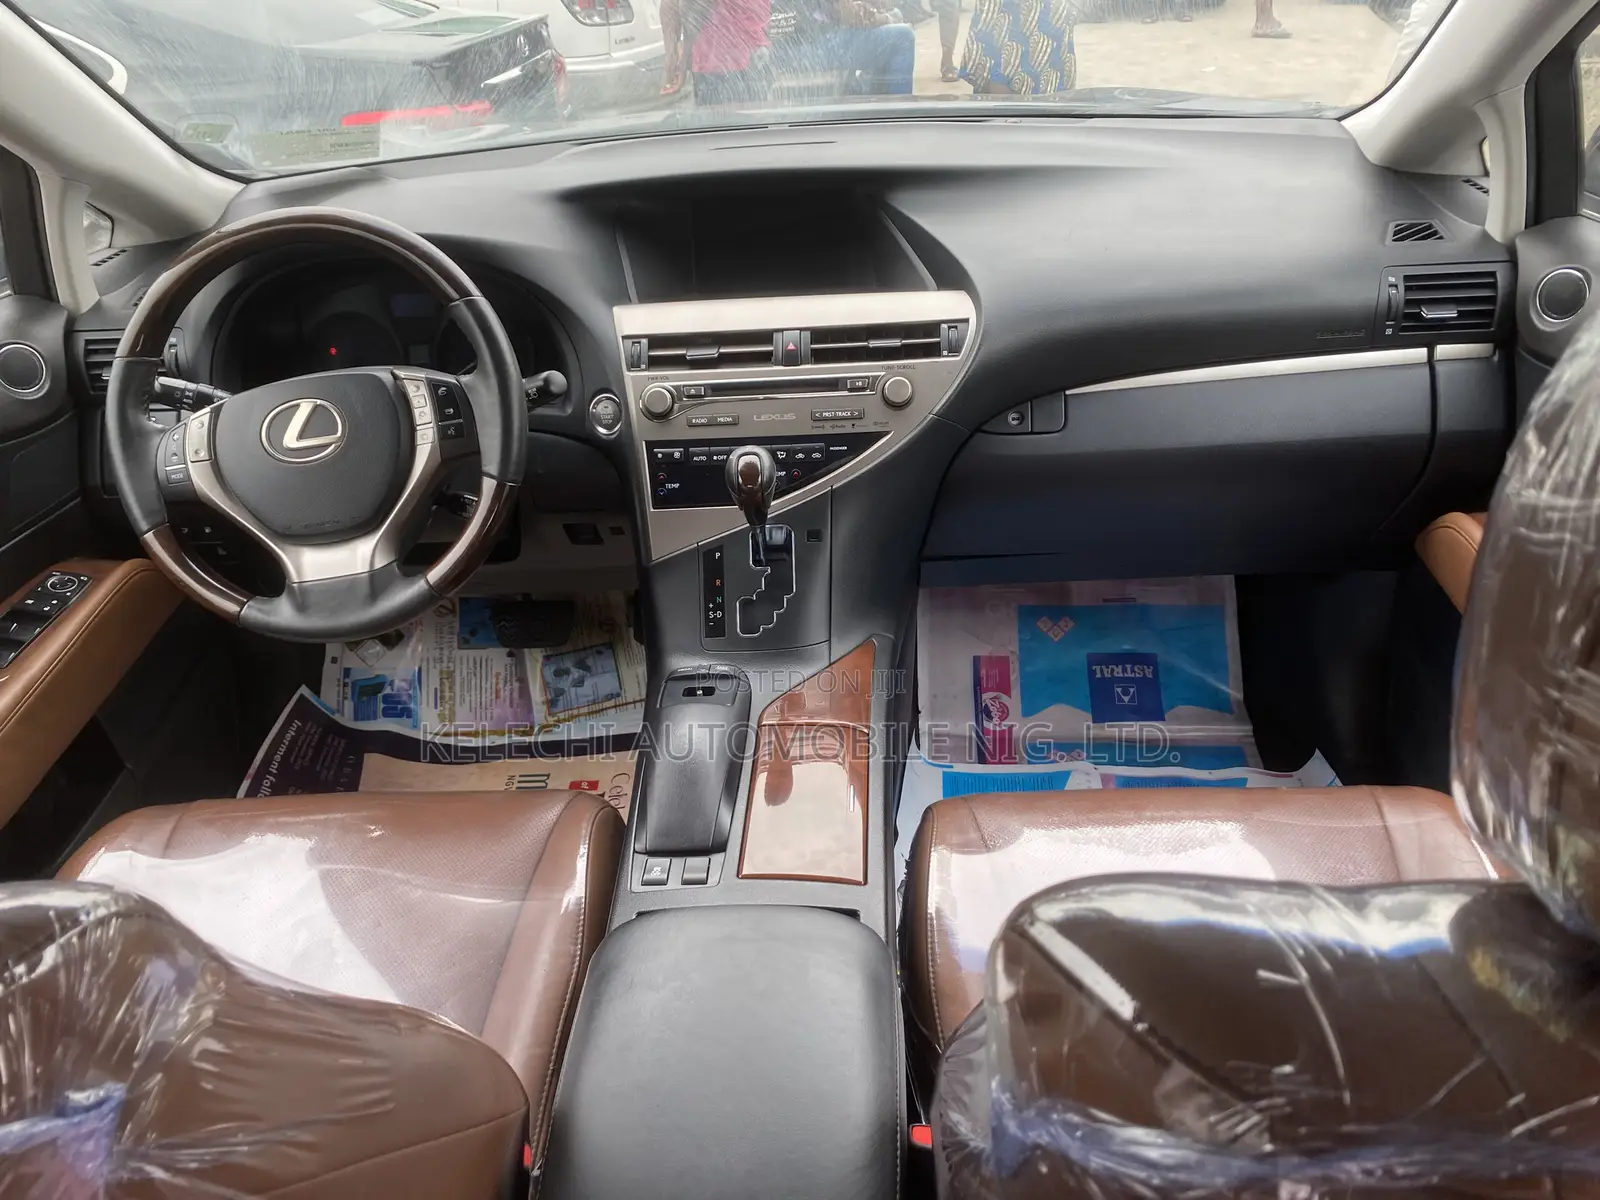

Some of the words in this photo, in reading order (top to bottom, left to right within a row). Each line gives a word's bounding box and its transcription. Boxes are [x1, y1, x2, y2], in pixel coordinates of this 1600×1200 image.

[753, 412, 797, 421] LEXUS
[715, 552, 721, 560] P
[1092, 664, 1154, 678] ASTRAL
